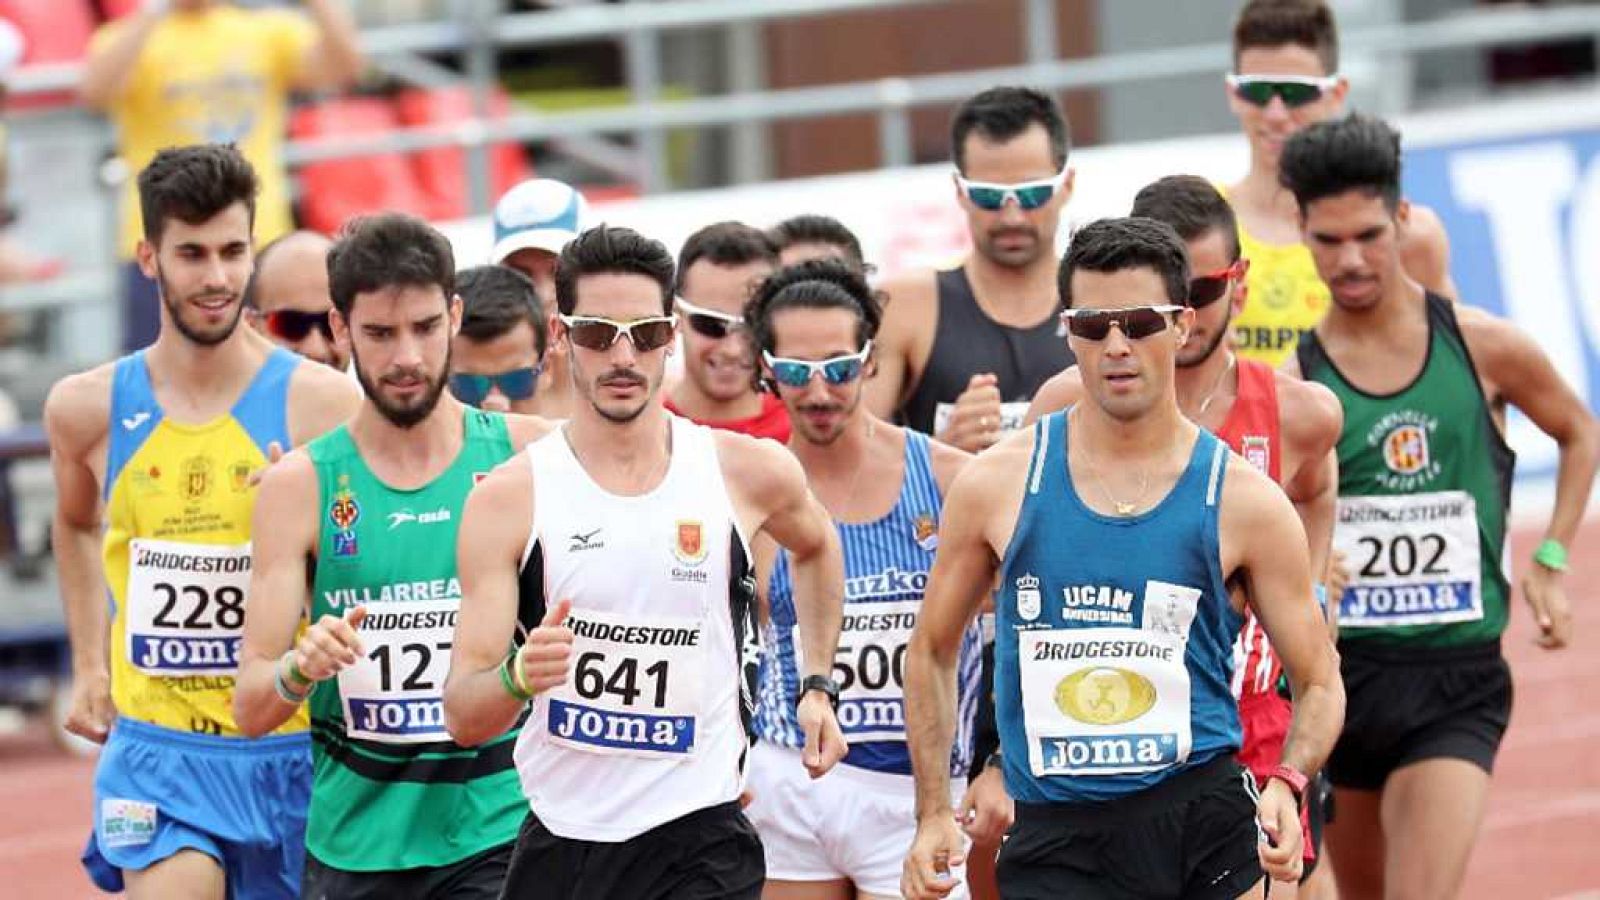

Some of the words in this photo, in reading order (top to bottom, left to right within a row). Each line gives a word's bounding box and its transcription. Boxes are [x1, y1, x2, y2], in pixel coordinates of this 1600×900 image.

[1358, 532, 1450, 577] 202
[151, 582, 245, 630] 228
[1063, 585, 1134, 612] UCAM
[1034, 641, 1174, 662] BRIDGESTONE
[574, 651, 669, 709] 641
